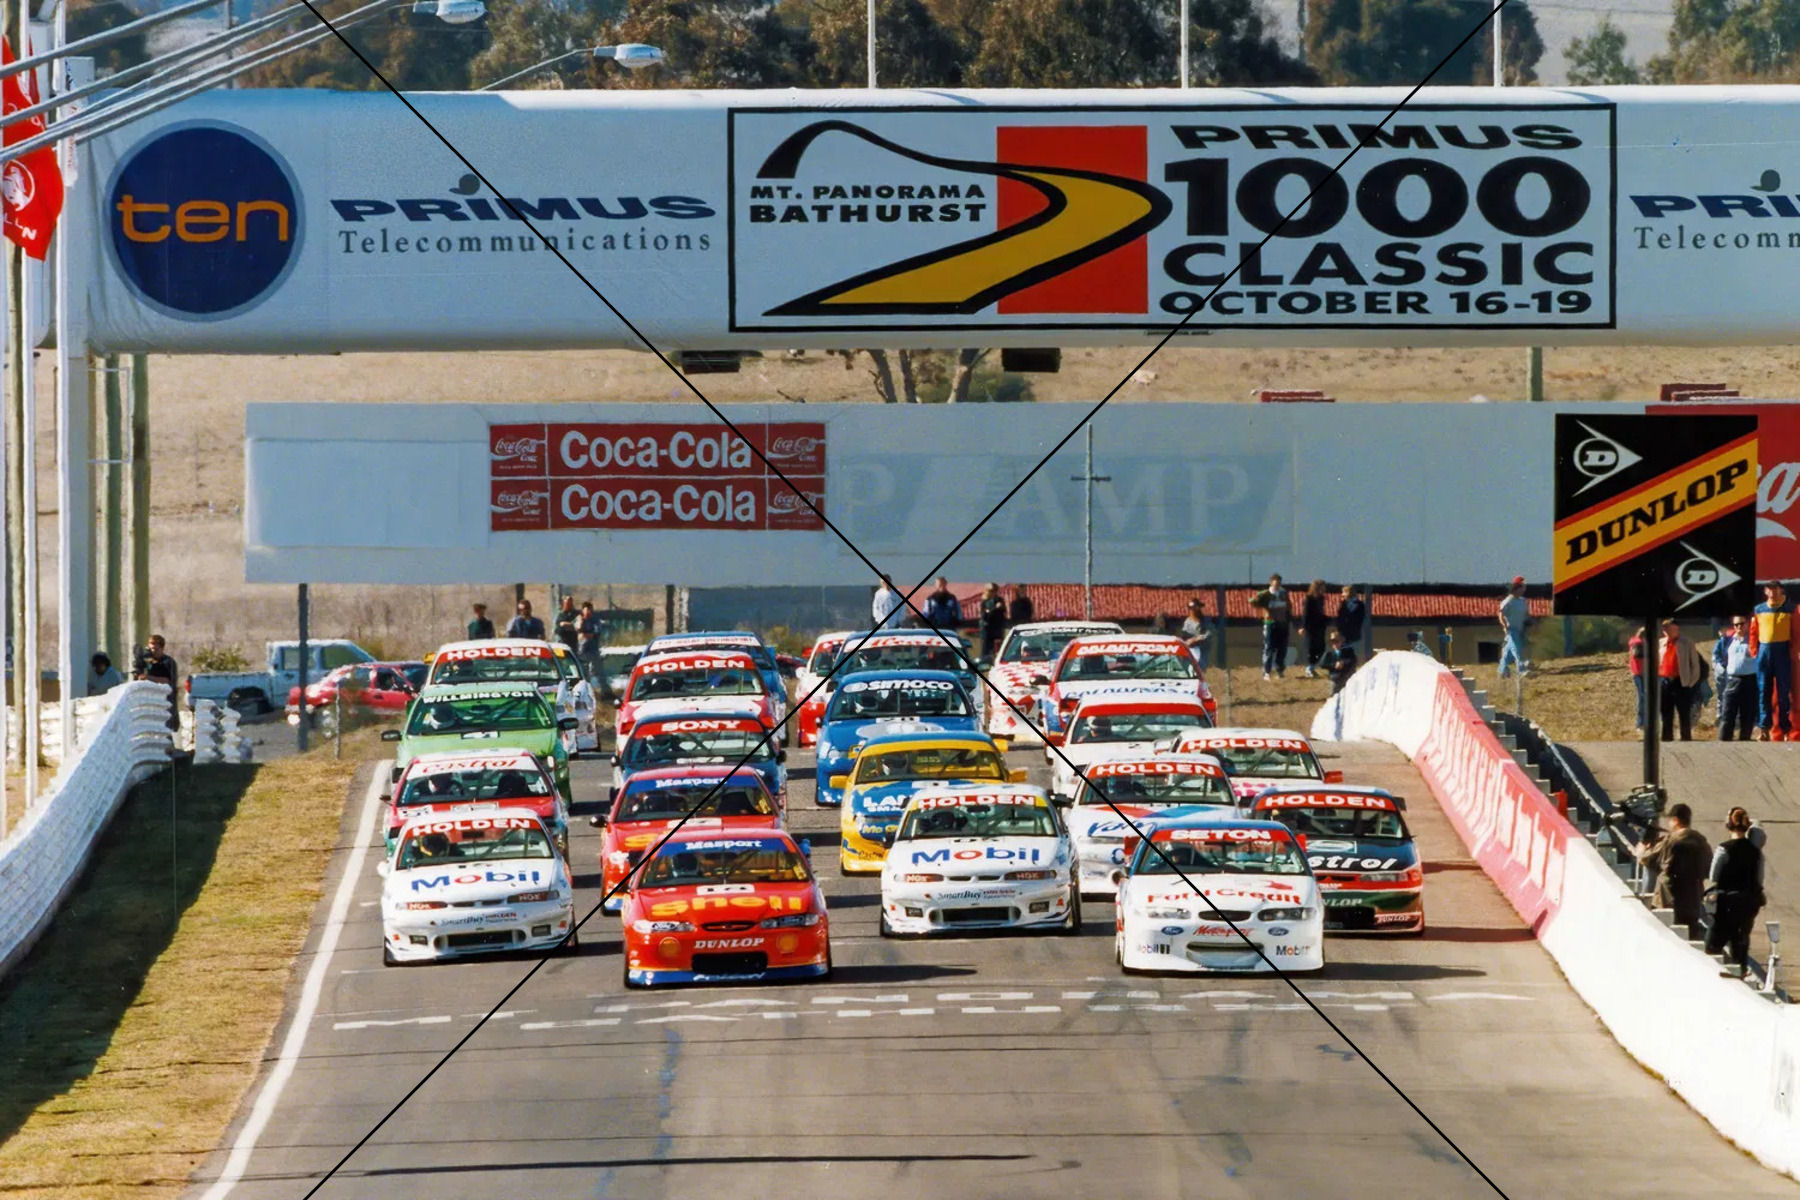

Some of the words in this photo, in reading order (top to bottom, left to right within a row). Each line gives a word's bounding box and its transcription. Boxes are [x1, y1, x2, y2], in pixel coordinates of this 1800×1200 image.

[1170, 124, 1583, 150] PRIMUS
[751, 185, 803, 200] MT.
[813, 184, 986, 200] PANORAMA
[1164, 156, 1591, 239] 1000
[330, 194, 717, 222] PRIMUS
[749, 203, 987, 223] BATHURST
[1629, 194, 1800, 218] PRI
[117, 195, 289, 242] ten
[338, 226, 711, 254] Telecommunications
[1163, 242, 1594, 286] CLASSIC
[1159, 290, 1432, 315] OCTOBER
[1449, 290, 1593, 315] 16-19
[561, 430, 752, 469] Coca-Cola
[562, 484, 756, 522] Coca-Cola
[1565, 458, 1749, 566] DUNLOP
[447, 647, 541, 660] HOLDEN
[643, 659, 745, 674] HOLDEN
[661, 720, 741, 732] SONY
[1187, 738, 1302, 750] HOLDEN
[422, 758, 518, 774] Castrol
[1096, 763, 1215, 776] HOLDEN
[918, 795, 1035, 809] HOLDEN
[1265, 794, 1386, 809] HOLDEN
[412, 817, 530, 836] HOLDEN
[1170, 829, 1272, 840] SETON
[685, 839, 763, 850] Masport
[911, 846, 1040, 865] Mobil
[1307, 855, 1398, 870] strol
[411, 869, 540, 892] Mobil
[1146, 889, 1211, 903] Ford
[1216, 888, 1302, 905] Credit
[693, 937, 765, 949] DUNLOP
